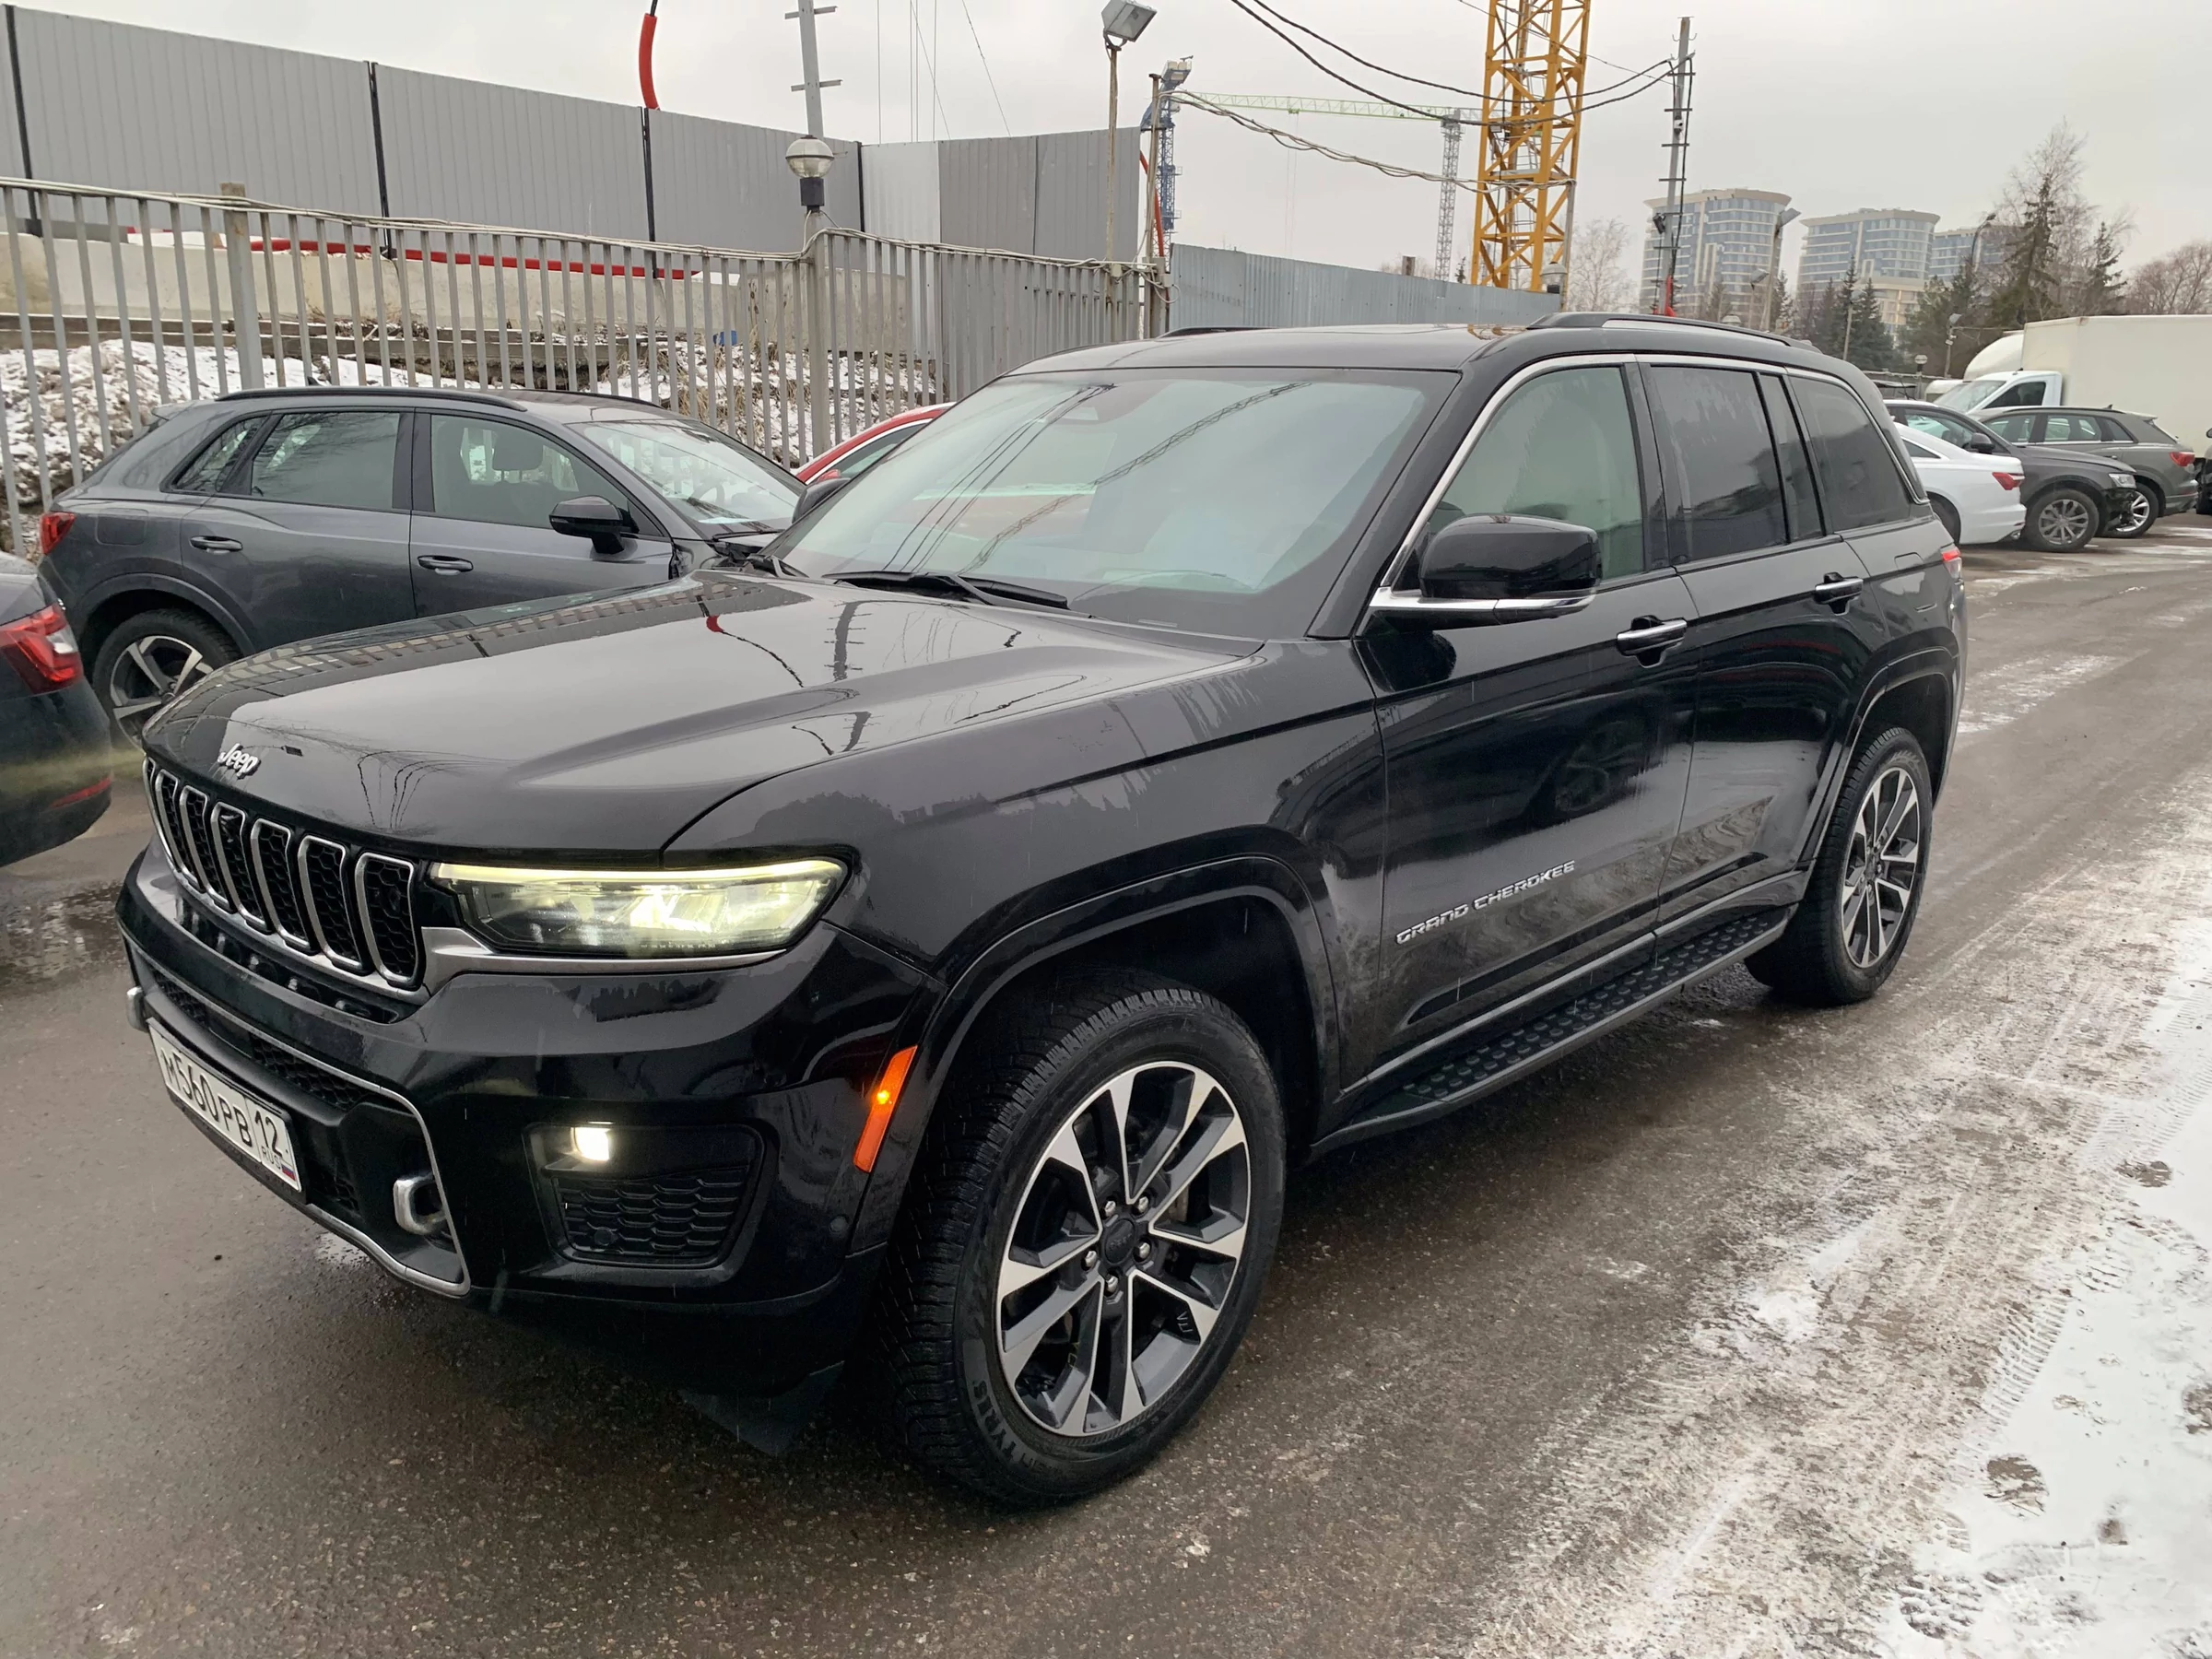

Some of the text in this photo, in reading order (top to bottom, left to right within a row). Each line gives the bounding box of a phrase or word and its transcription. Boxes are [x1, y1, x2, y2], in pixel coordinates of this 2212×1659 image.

[218, 743, 259, 777] Jeep
[1396, 859, 1575, 944] GRAND CHEROKEE
[254, 1110, 283, 1158] 12
[261, 1145, 281, 1171] RUS
